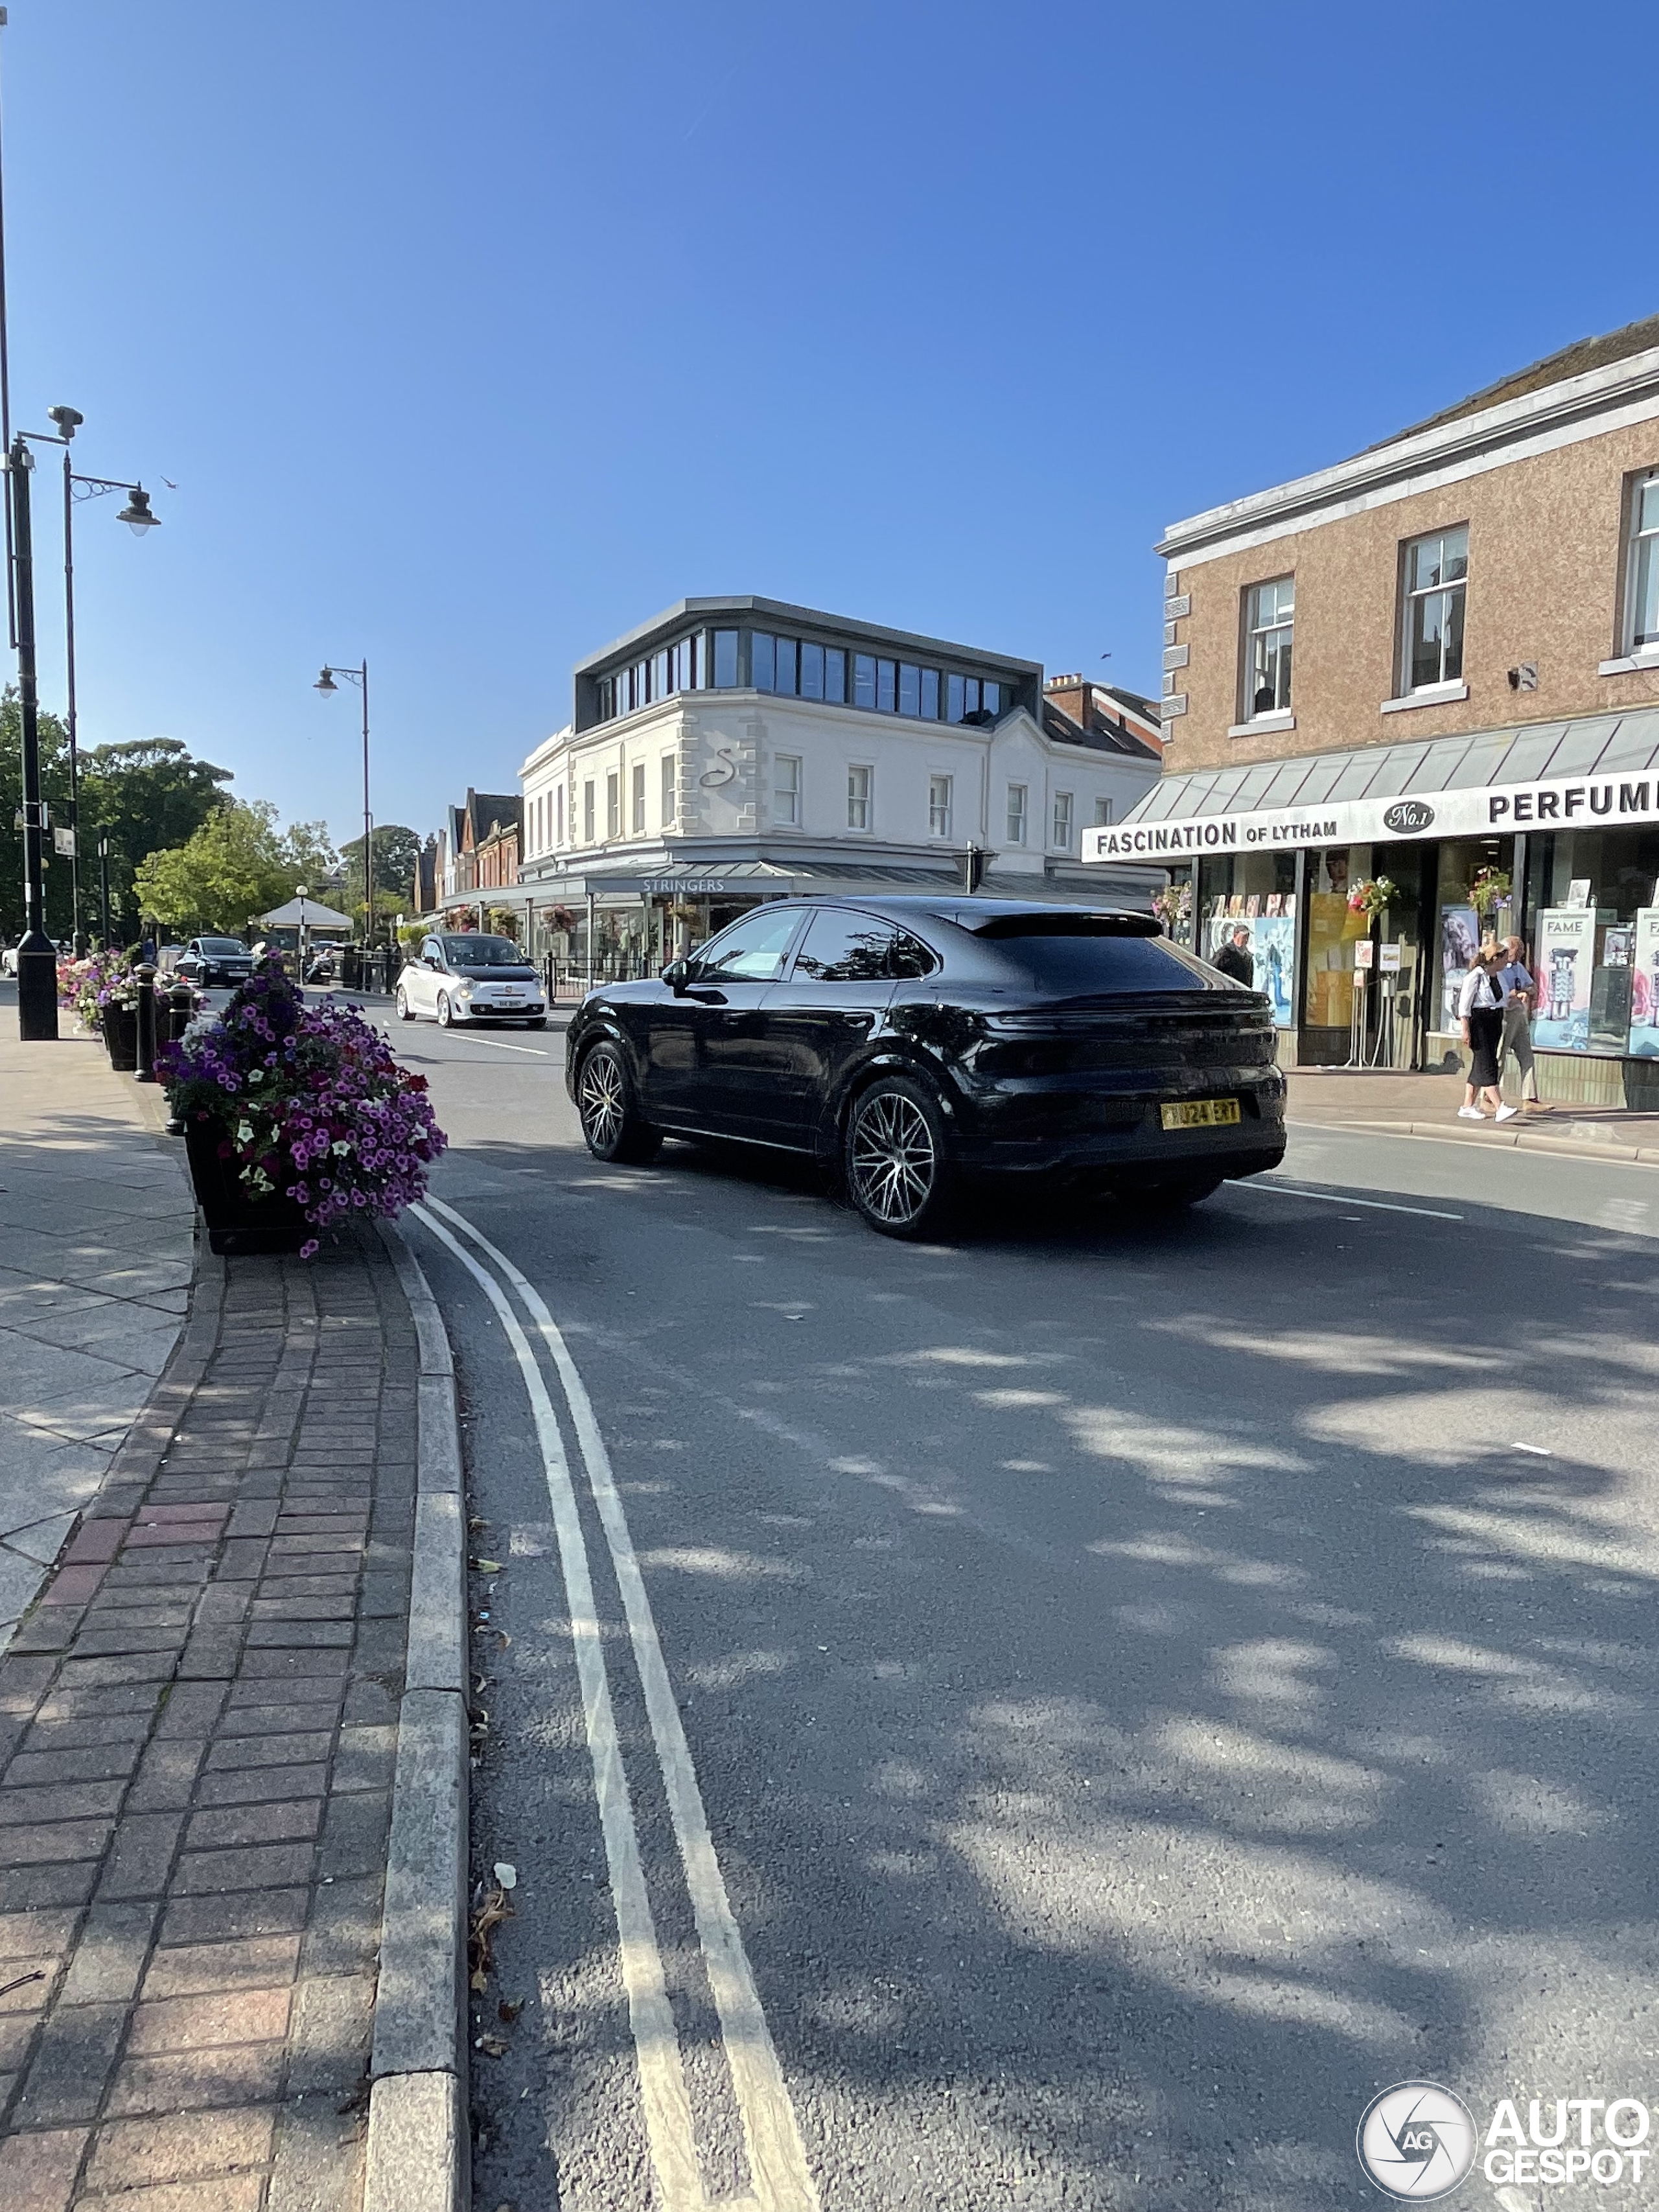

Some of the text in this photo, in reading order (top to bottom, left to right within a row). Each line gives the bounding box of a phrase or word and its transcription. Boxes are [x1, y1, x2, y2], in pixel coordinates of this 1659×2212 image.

[1490, 780, 1659, 823] PERFUM
[1388, 804, 1428, 826] No.1
[1097, 821, 1338, 854] FASCINATION OF LYTHAM
[643, 879, 725, 891] STRINGERS
[1547, 922, 1583, 933] FAME
